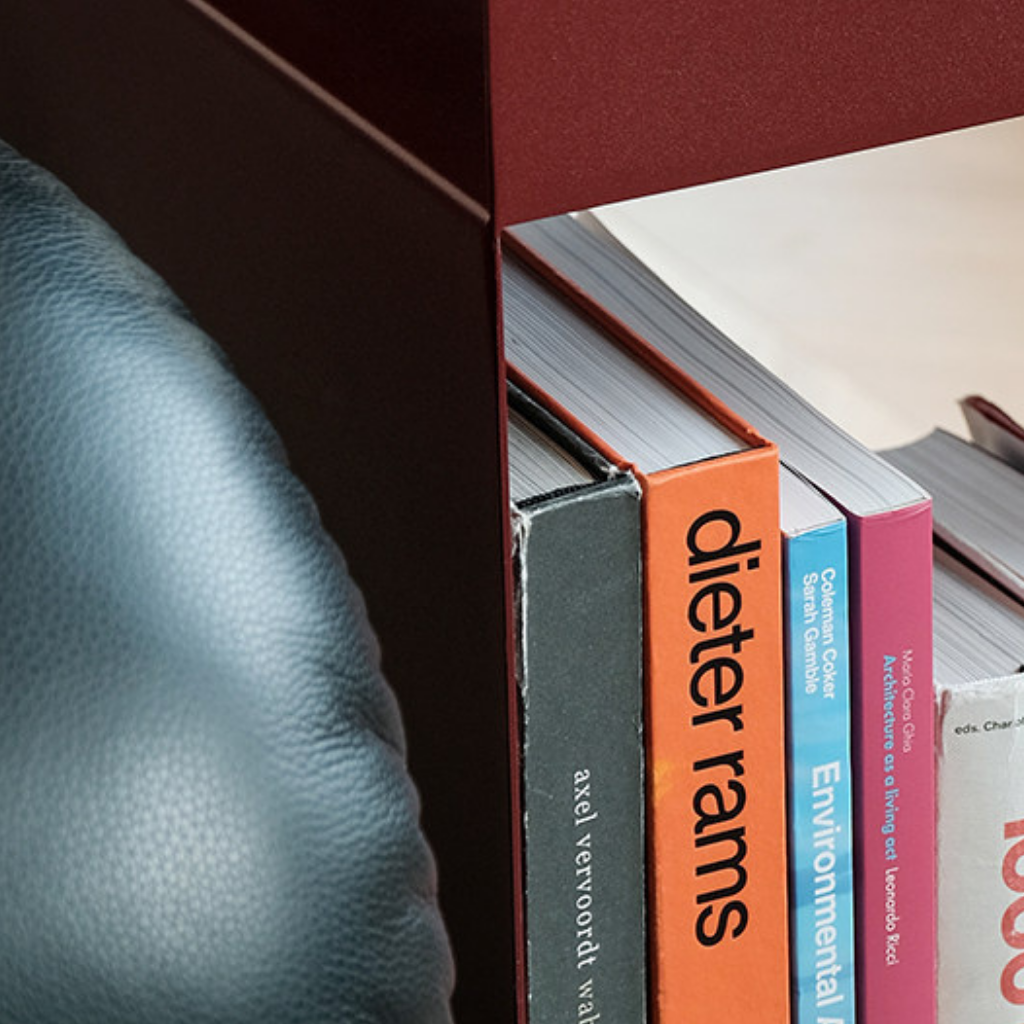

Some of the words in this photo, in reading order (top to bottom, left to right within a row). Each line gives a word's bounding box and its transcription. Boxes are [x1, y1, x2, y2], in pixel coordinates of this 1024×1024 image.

[686, 509, 762, 732] dieter
[803, 572, 819, 625] Sarah
[820, 566, 837, 646] Coleman
[803, 627, 821, 695] Gamble
[821, 648, 838, 700] Coker
[883, 654, 898, 750] Architecture
[883, 753, 895, 773] as
[884, 775, 895, 787] a
[573, 768, 599, 827] axel
[881, 789, 900, 835] living
[692, 749, 750, 948] rams
[885, 837, 898, 861] act
[575, 832, 600, 970] vervoordt
[811, 760, 845, 1008] Environmental
[885, 867, 901, 933] Leonardo
[885, 933, 901, 966] Ricci
